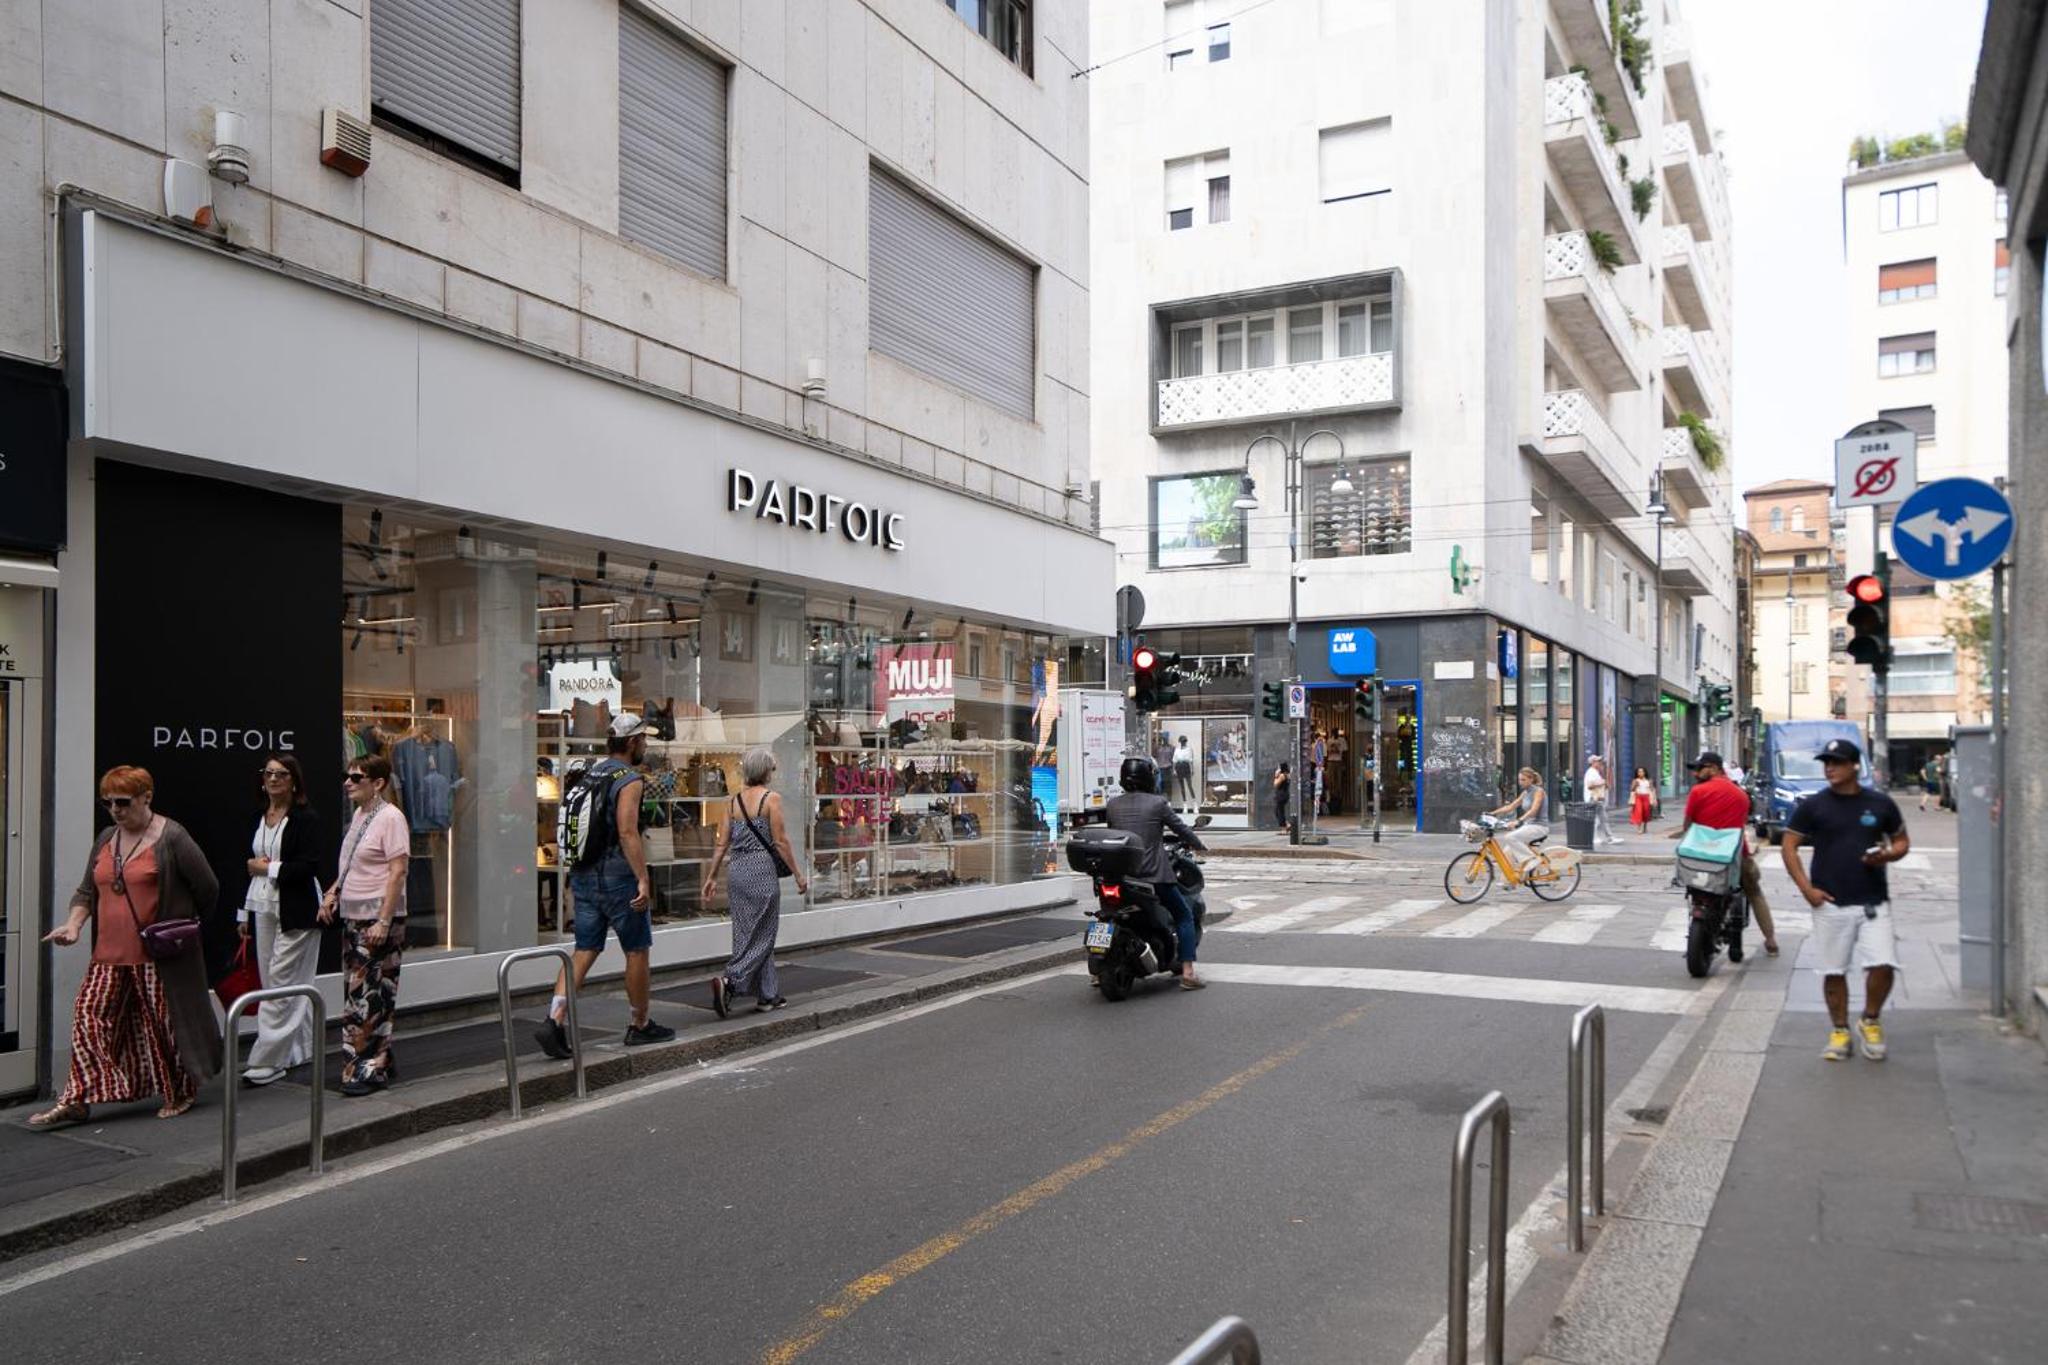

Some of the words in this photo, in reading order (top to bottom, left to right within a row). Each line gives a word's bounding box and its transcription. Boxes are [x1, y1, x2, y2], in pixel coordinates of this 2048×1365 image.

[728, 468, 905, 551] PARFOIS
[1332, 642, 1357, 653] LAB
[1333, 632, 1355, 642] AW
[559, 677, 615, 692] PANDORA
[888, 658, 953, 691] MUJI
[153, 726, 295, 750] PARFOIS
[833, 766, 896, 795] SALDI
[838, 797, 892, 826] SALE
